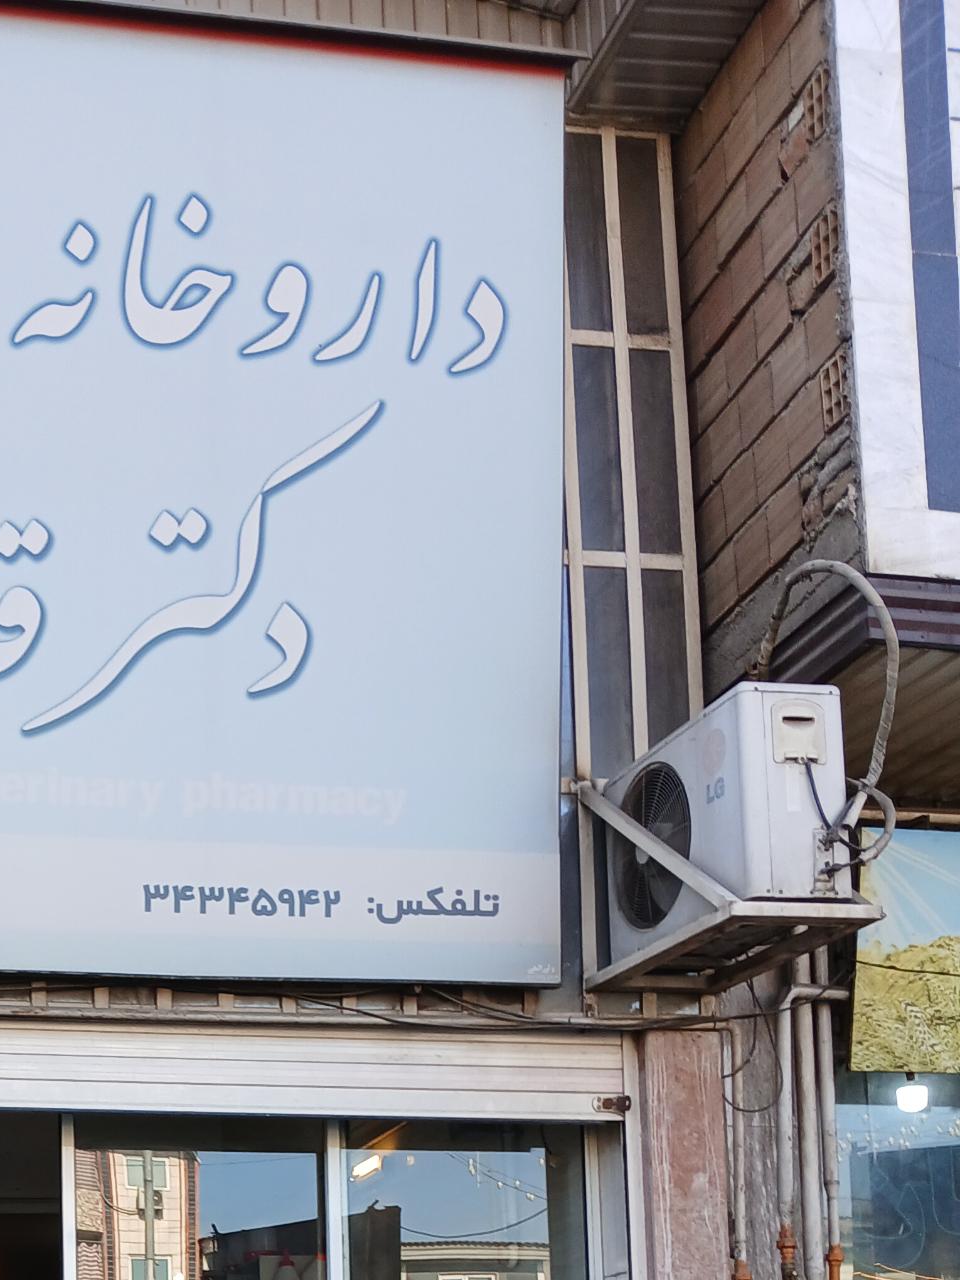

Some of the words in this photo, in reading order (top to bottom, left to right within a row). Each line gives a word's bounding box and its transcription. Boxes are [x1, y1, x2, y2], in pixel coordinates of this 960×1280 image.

[21, 399, 385, 736] دکتر
[181, 772, 408, 826] pharmacy
[705, 776, 726, 804] LG
[142, 882, 341, 919] ۳۴۳۴۵۹۴۲
